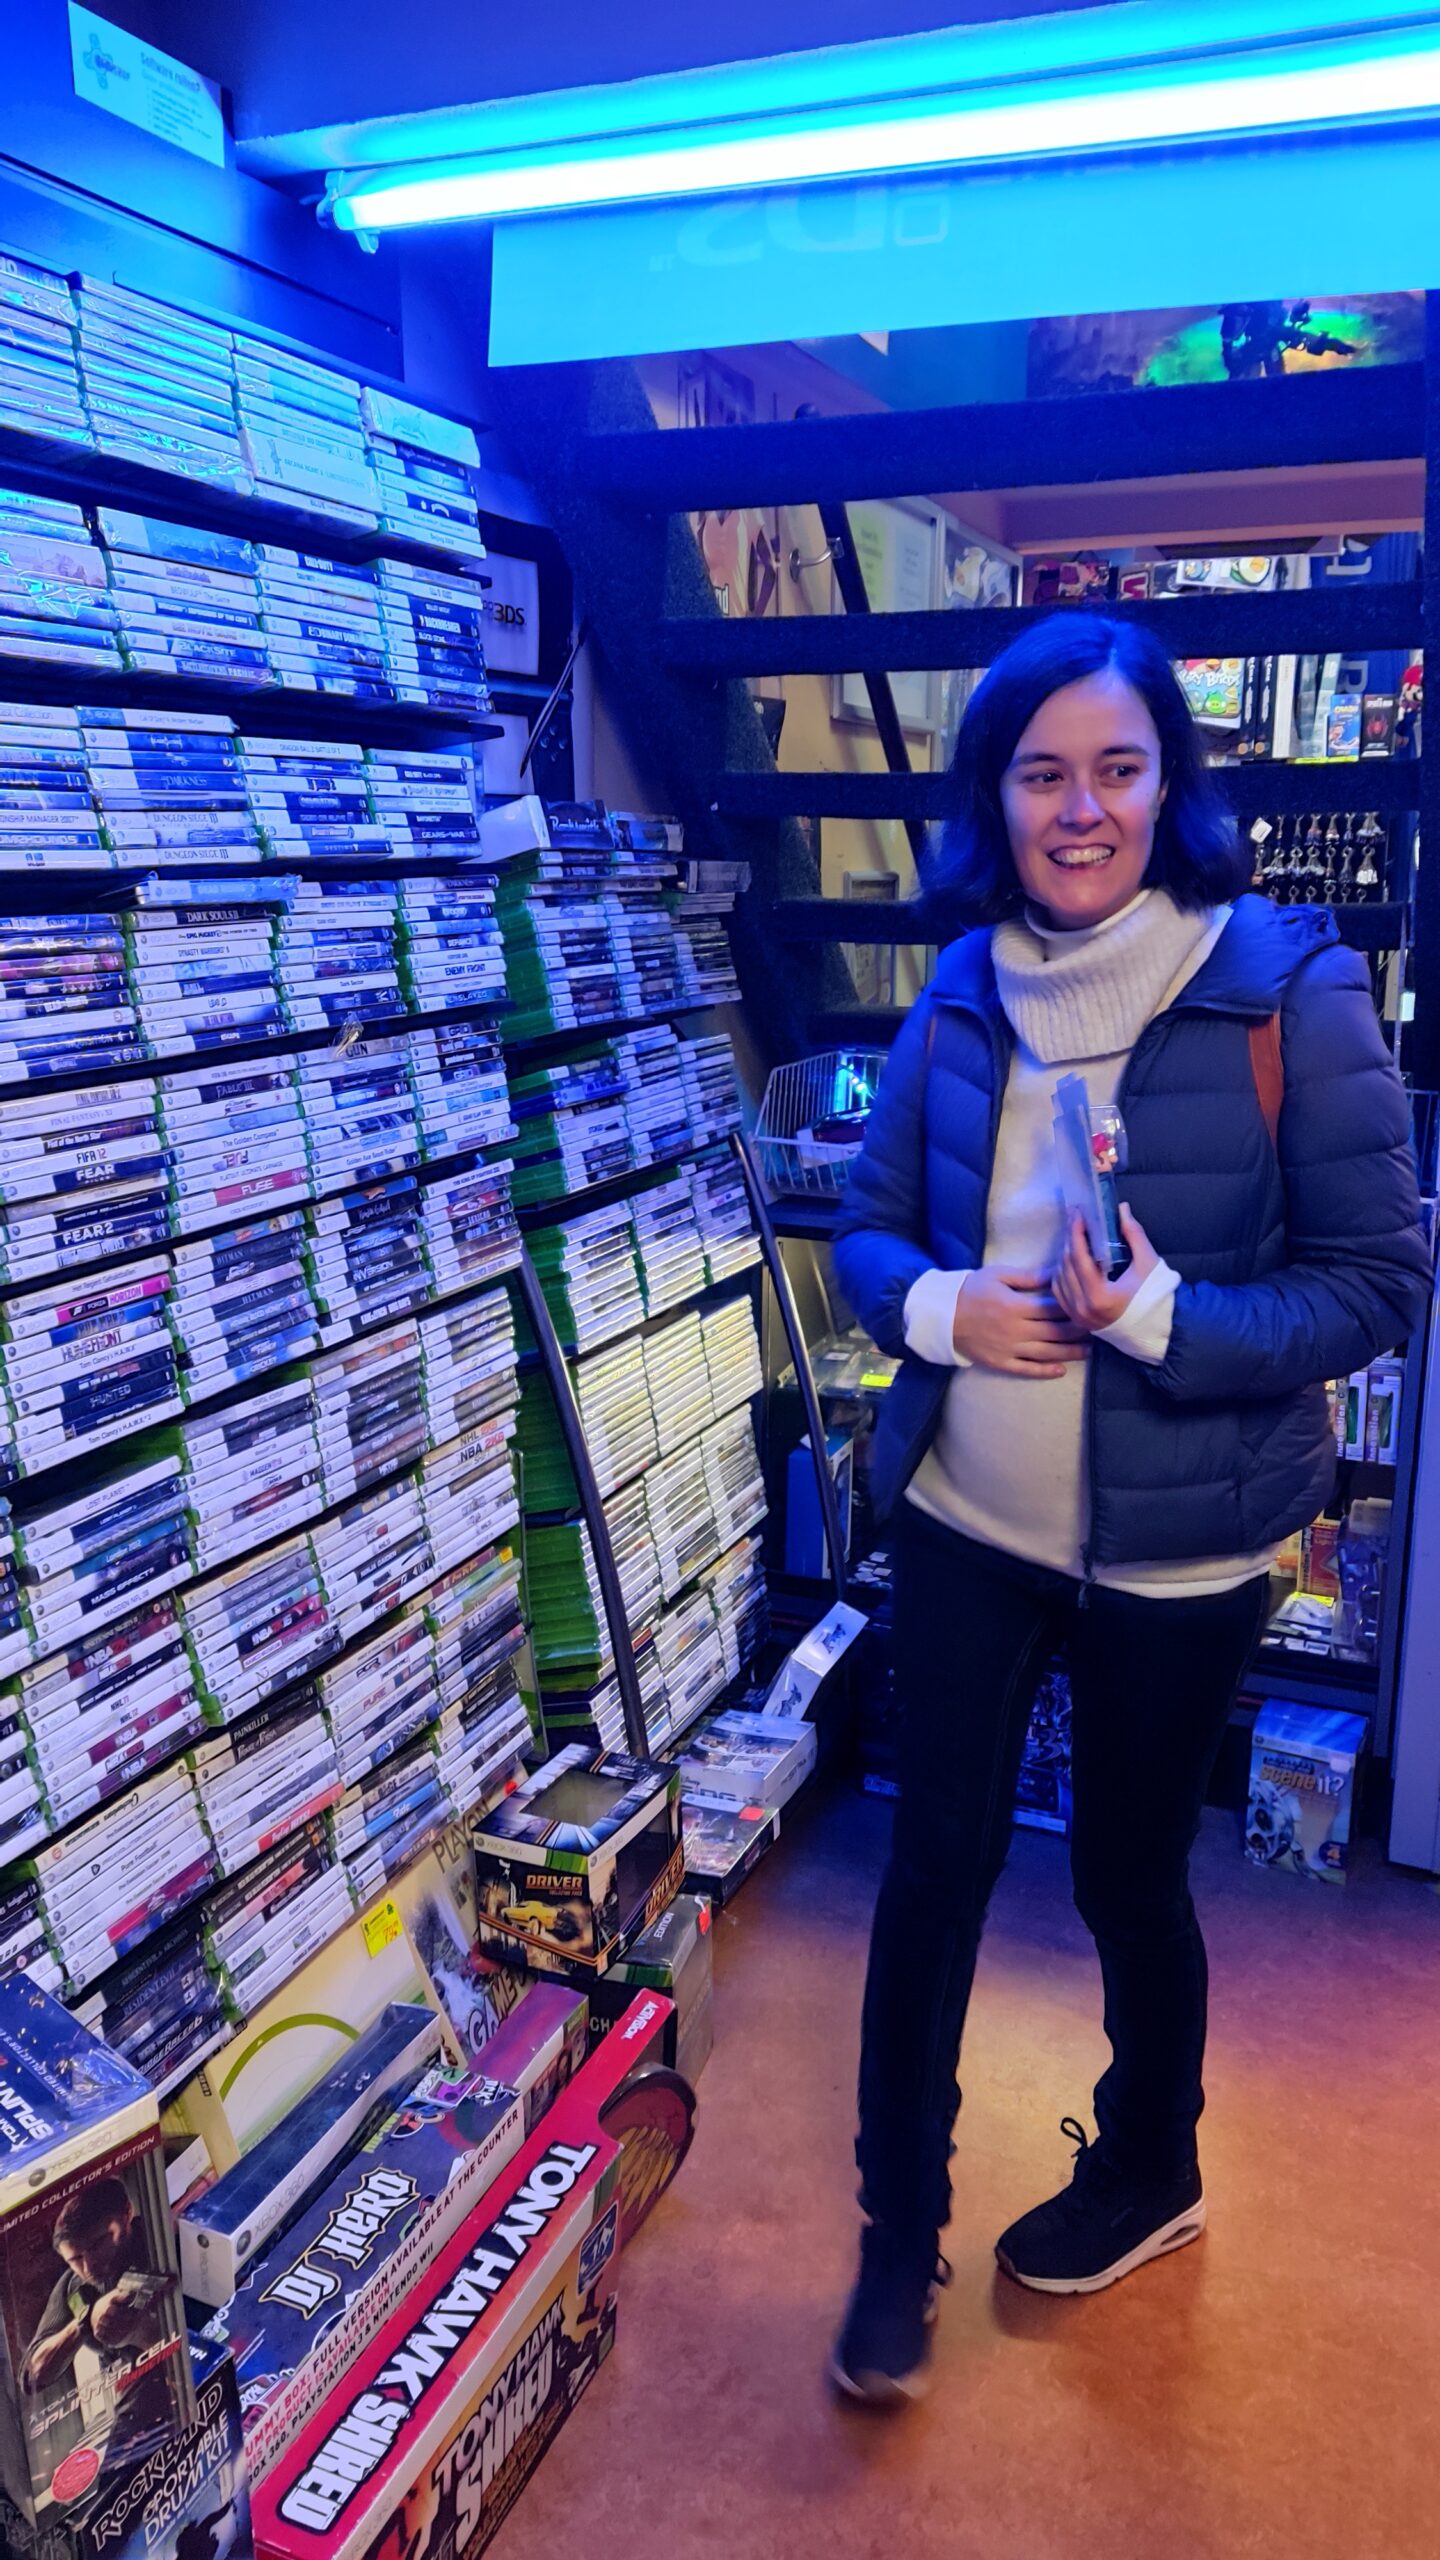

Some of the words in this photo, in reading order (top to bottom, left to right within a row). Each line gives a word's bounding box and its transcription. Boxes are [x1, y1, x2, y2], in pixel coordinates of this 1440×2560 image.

[186, 910, 207, 923] DARK
[345, 1042, 368, 1059] GUN
[76, 1149, 96, 1165] FIFA
[97, 1147, 106, 1160] 12
[221, 1138, 231, 1149] The
[232, 1133, 250, 1146] Golden
[345, 1156, 361, 1167] Golden
[362, 1153, 371, 1163] Axe
[241, 1179, 275, 1198] FUSE
[86, 1297, 106, 1309] FORZA
[109, 1283, 143, 1306] HORIZON
[79, 1358, 93, 1371] Tom
[89, 1384, 131, 1407] HUNTED
[87, 1432, 101, 1445] Tom
[102, 1424, 122, 1440] Clancy's
[459, 1440, 482, 1463] NBA
[483, 1428, 506, 1450] 2K6
[460, 1427, 479, 1448] NHL
[480, 1418, 498, 1437] 2K6
[84, 1493, 102, 1511] LOST
[90, 1584, 113, 1606] MASS
[252, 1623, 271, 1647] NBA
[84, 1647, 114, 1673] NBA
[233, 1712, 268, 1741] PAINKILLER
[120, 1757, 147, 1783] NBA
[119, 1857, 133, 1874] Pure
[526, 1874, 583, 1889] DRIVER
[644, 1853, 685, 1923] DRIVER
[654, 1911, 675, 1938] EDITION
[623, 1999, 659, 2041] ACTIVISION
[41, 2161, 113, 2213] COLLECTOR'S
[114, 2134, 156, 2169] EDITION
[47, 2145, 87, 2176] XBOX
[254, 2198, 283, 2237] XBOX
[282, 2173, 306, 2203] 360
[501, 2143, 597, 2260] TONY
[270, 2268, 338, 2322] DJ
[317, 2169, 415, 2264] HERO
[313, 2334, 341, 2372] FULL
[344, 2277, 389, 2333] VERSION
[389, 2203, 443, 2280] AVAILABLE
[442, 2191, 456, 2212] AT
[457, 2165, 477, 2190] THE
[476, 2109, 520, 2166] COUNTER
[373, 2246, 516, 2402] HAWK
[515, 2294, 566, 2369] HAWK
[291, 2341, 356, 2427] PLAYSTATION
[372, 2261, 420, 2324] NINTENDO
[29, 2364, 132, 2441] SPLINTER
[135, 2331, 182, 2368] CELL
[263, 2382, 312, 2450] PRODUCT
[325, 2300, 376, 2366] AVAILABLE
[434, 2372, 515, 2491] TONY
[456, 2340, 553, 2531] SHRED
[155, 2410, 230, 2515] PORTABLE
[281, 2393, 411, 2532] SHRED
[144, 2463, 205, 2545] DRUM
[204, 2428, 230, 2471] KIT
